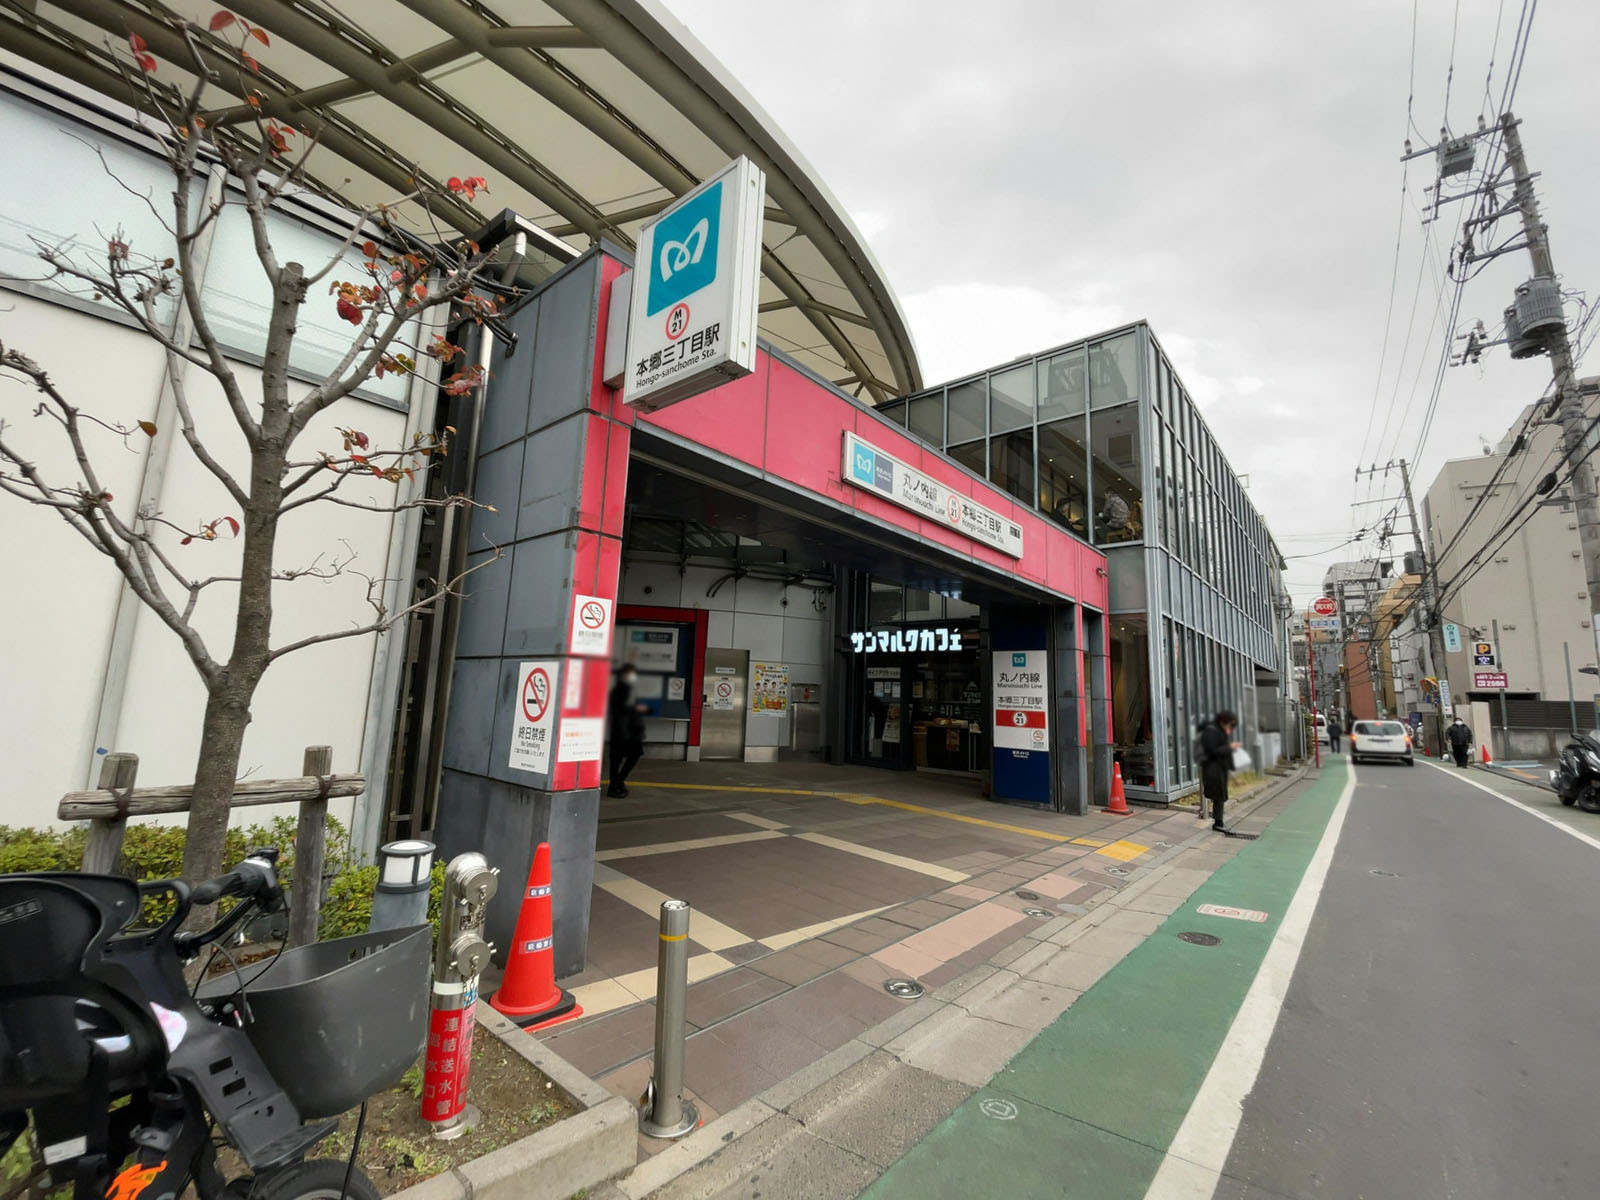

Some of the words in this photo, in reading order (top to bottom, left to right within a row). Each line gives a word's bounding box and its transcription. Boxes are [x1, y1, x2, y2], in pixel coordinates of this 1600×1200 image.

[674, 309, 682, 320] M
[671, 319, 682, 333] 21
[636, 322, 720, 377] 本郷三丁目駅
[636, 355, 700, 389] Hongo-sanchome
[701, 348, 717, 360] Sta.
[903, 473, 938, 500] 丸ノ内線
[903, 488, 934, 510] Marunouchi
[962, 504, 1002, 534] 本郷三丁目駅
[850, 628, 963, 653] サンマルクカフェ
[1478, 644, 1489, 654] P
[999, 672, 1040, 683] 丸ノ内線
[997, 695, 1043, 705] 本郷三丁目駅
[518, 726, 546, 742] 終日禁煙
[437, 1016, 460, 1116] 連結送水管
